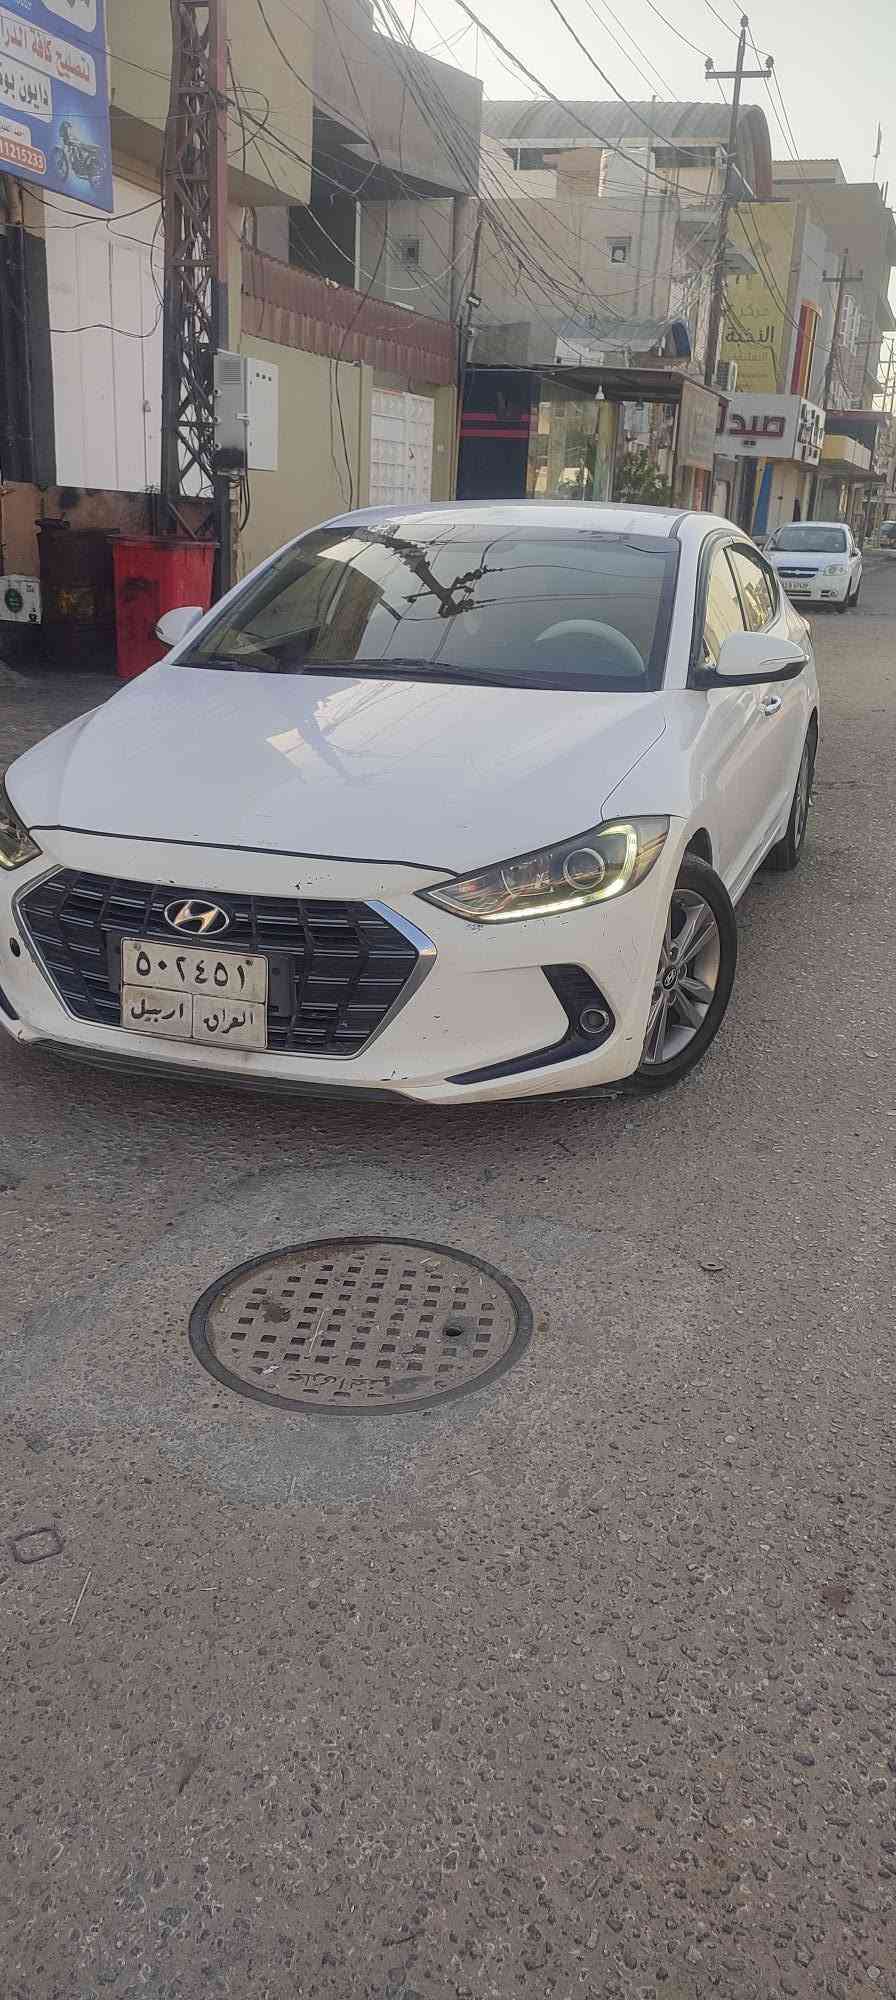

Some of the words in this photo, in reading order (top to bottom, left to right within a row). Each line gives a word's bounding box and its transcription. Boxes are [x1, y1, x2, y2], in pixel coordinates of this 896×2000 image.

[0, 15, 28, 49] الدرا
[32, 30, 52, 63] كافة
[715, 404, 787, 447] صيدل
[136, 951, 246, 992] ٥٠٢٤٥١
[130, 998, 184, 1023] اربيل
[203, 1008, 255, 1034] العراق
